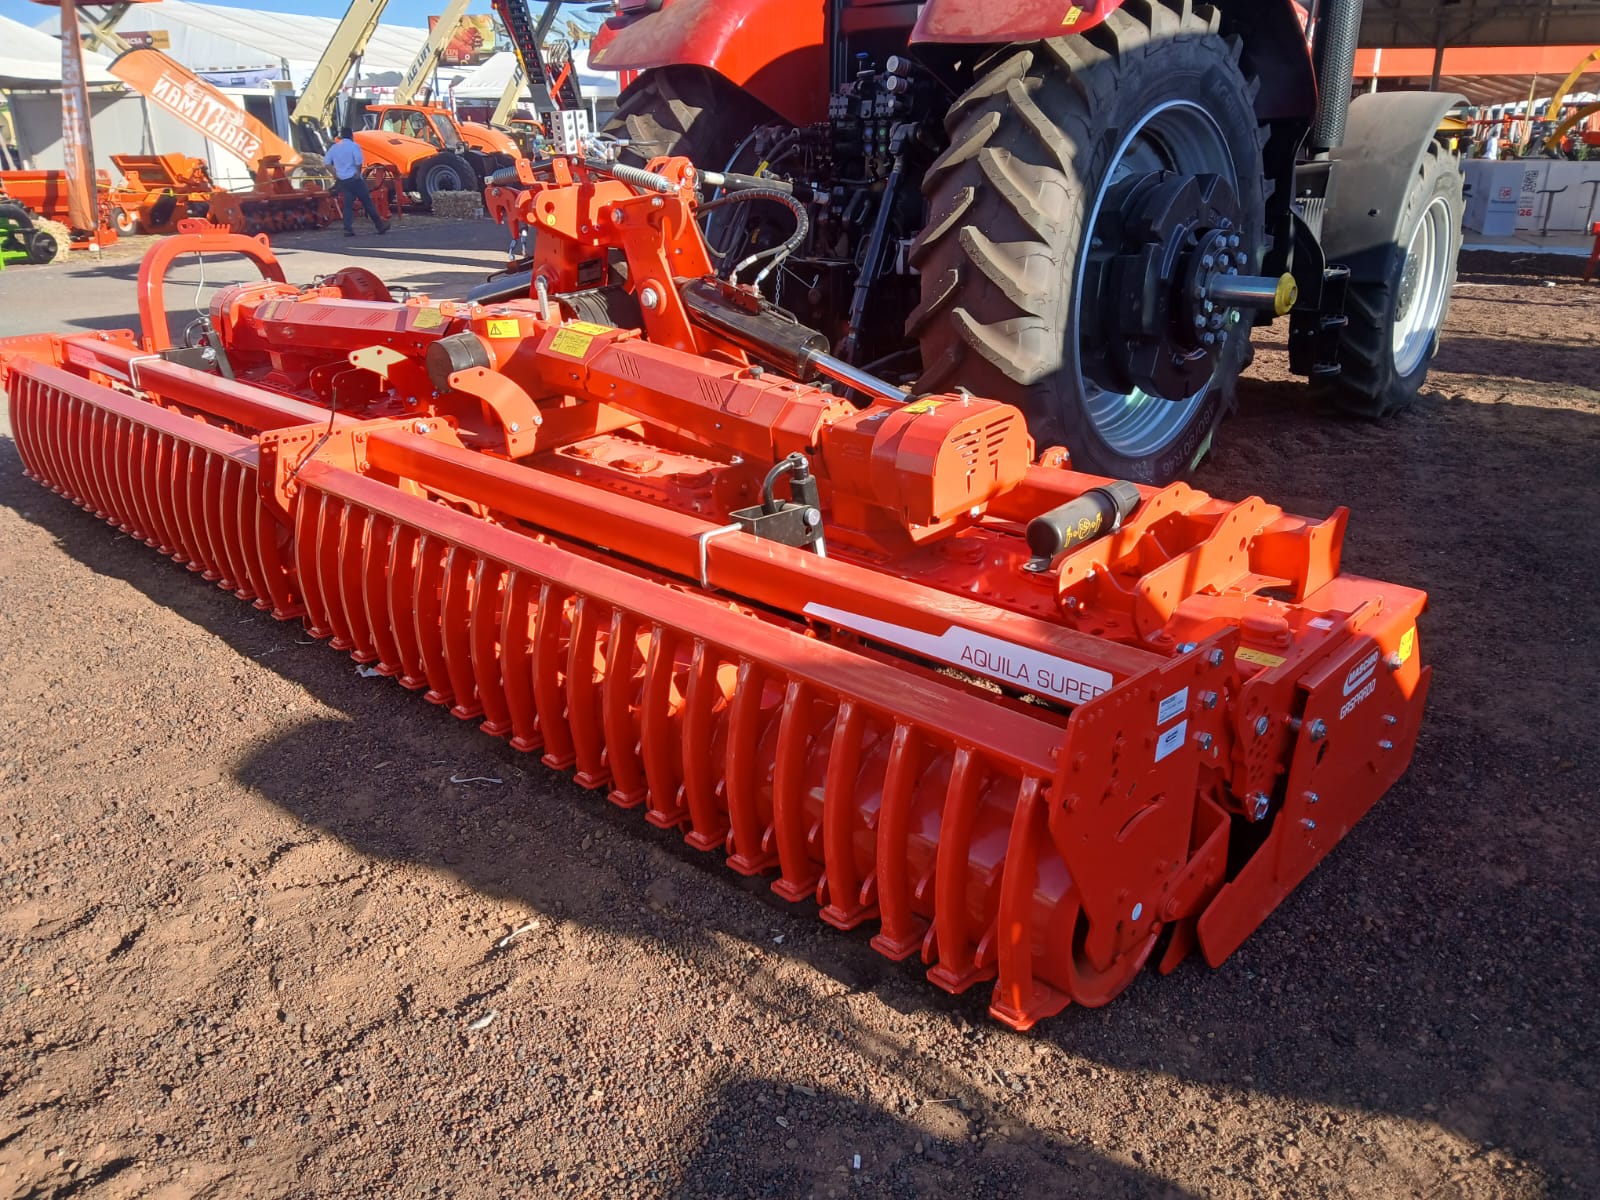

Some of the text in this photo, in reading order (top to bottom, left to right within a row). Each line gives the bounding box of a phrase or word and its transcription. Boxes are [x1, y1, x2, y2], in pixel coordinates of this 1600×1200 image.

[407, 42, 430, 87] JLG LIFT
[960, 645, 1030, 682] AQUILA
[1339, 677, 1377, 720] GASPARDO
